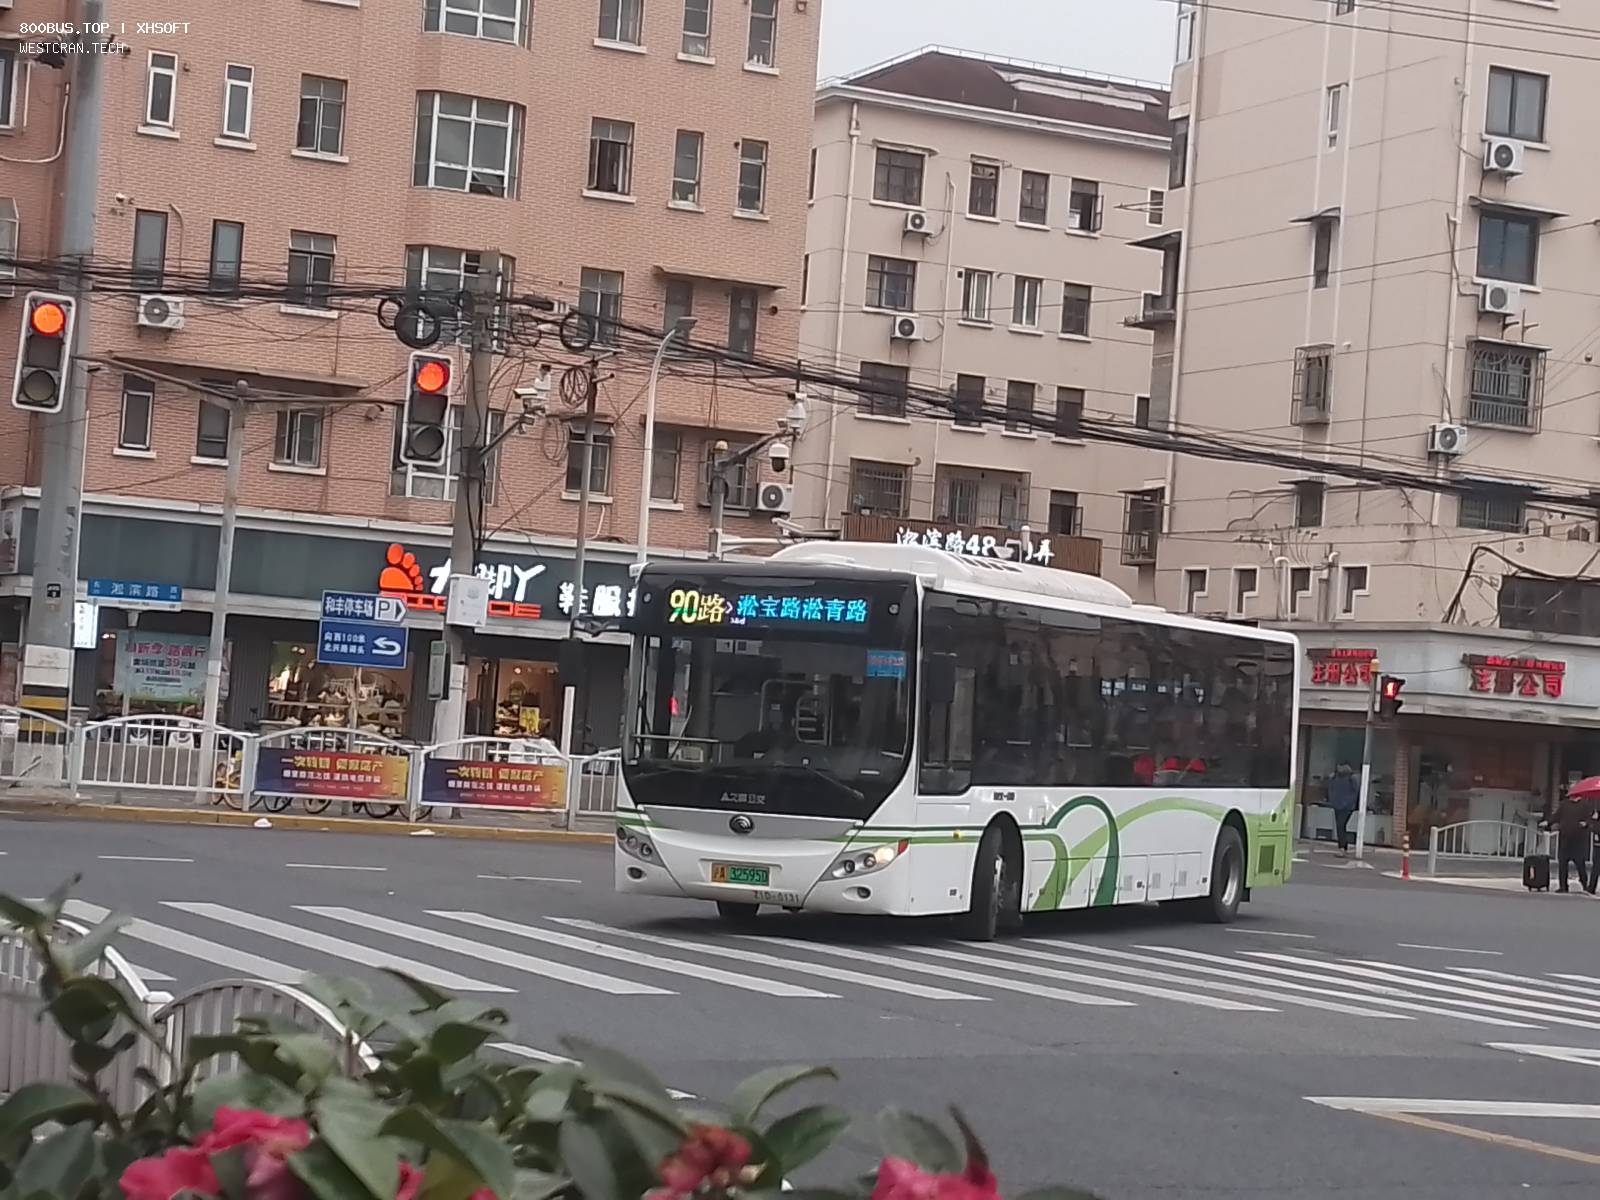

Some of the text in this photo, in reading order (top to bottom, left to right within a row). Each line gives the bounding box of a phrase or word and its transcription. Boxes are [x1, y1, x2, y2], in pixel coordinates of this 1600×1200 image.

[378, 600, 390, 618] P
[669, 589, 867, 625] 90路 淞宝路淞青路
